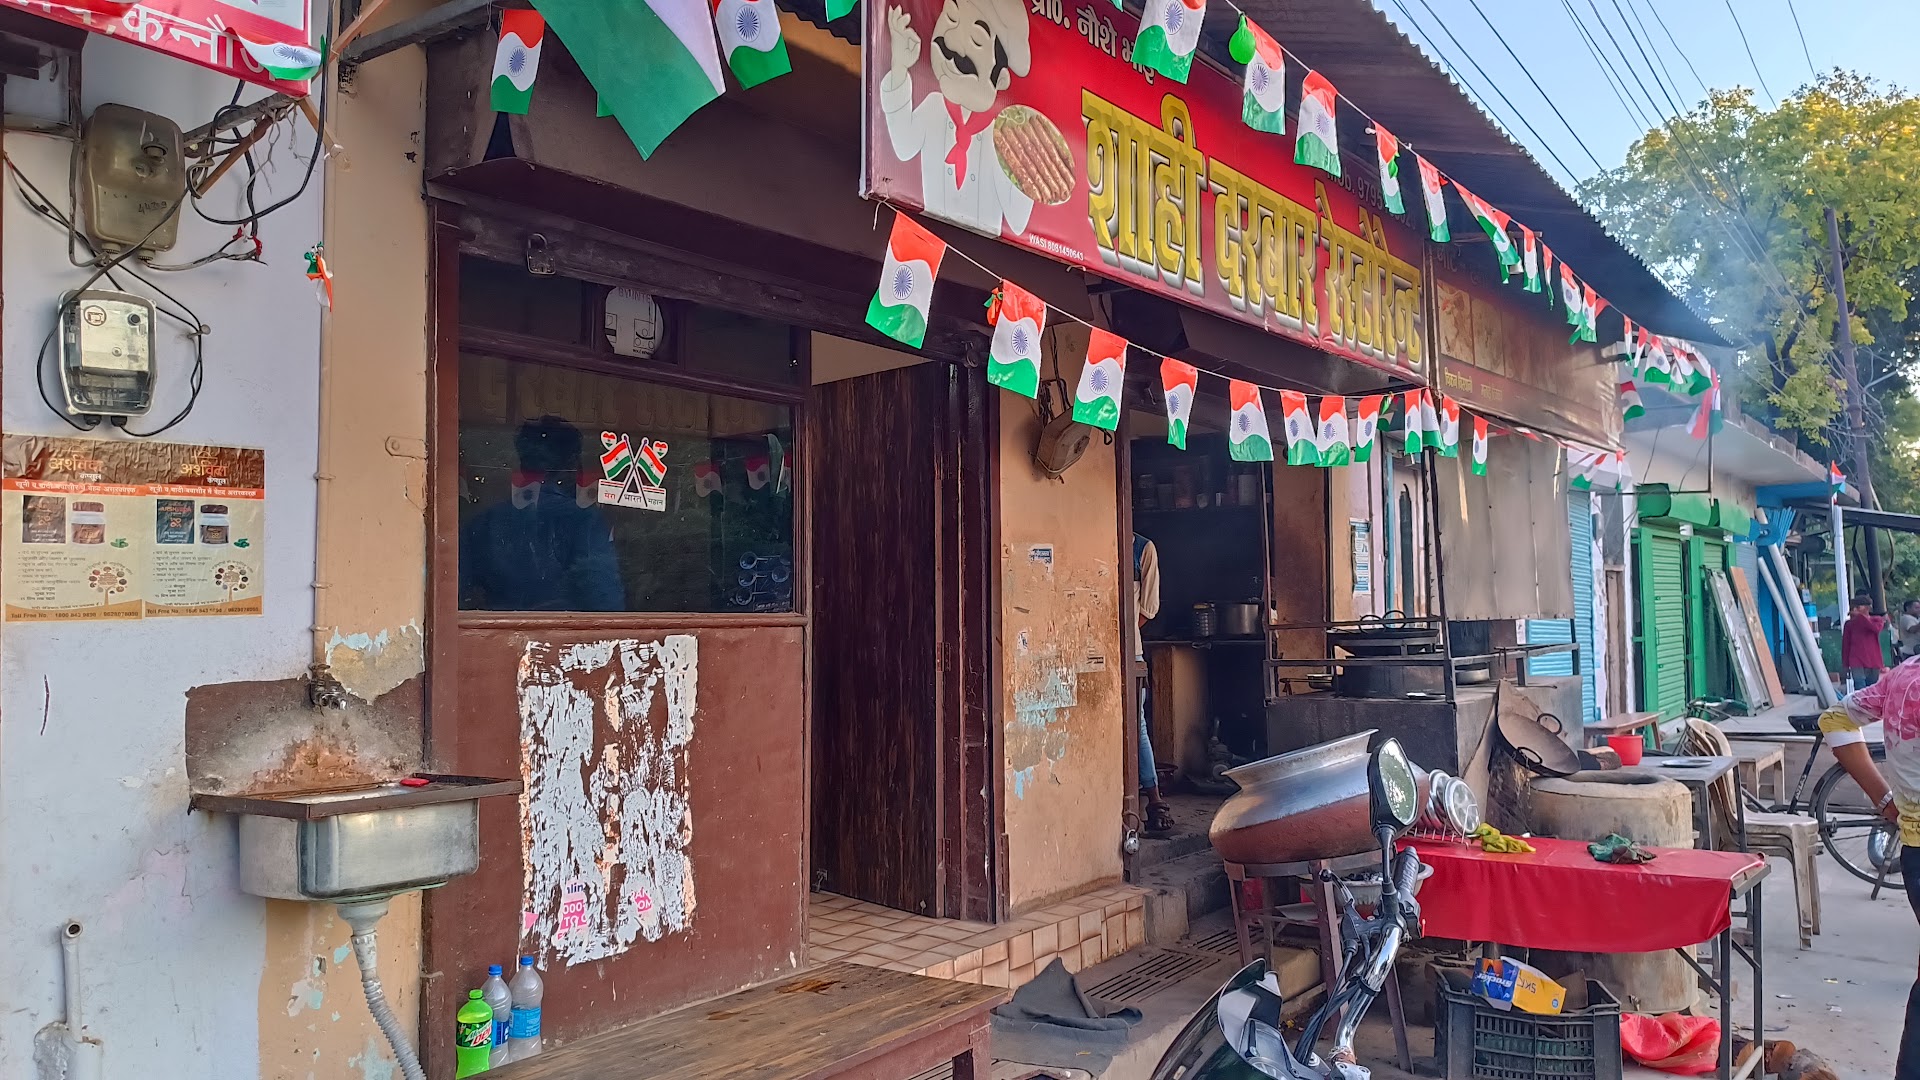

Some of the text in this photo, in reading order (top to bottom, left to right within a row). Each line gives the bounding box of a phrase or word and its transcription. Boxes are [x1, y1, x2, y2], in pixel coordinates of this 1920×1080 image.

[1082, 87, 1206, 295] शाही
[1209, 155, 1319, 336] दरबार
[624, 493, 642, 503] भारत
